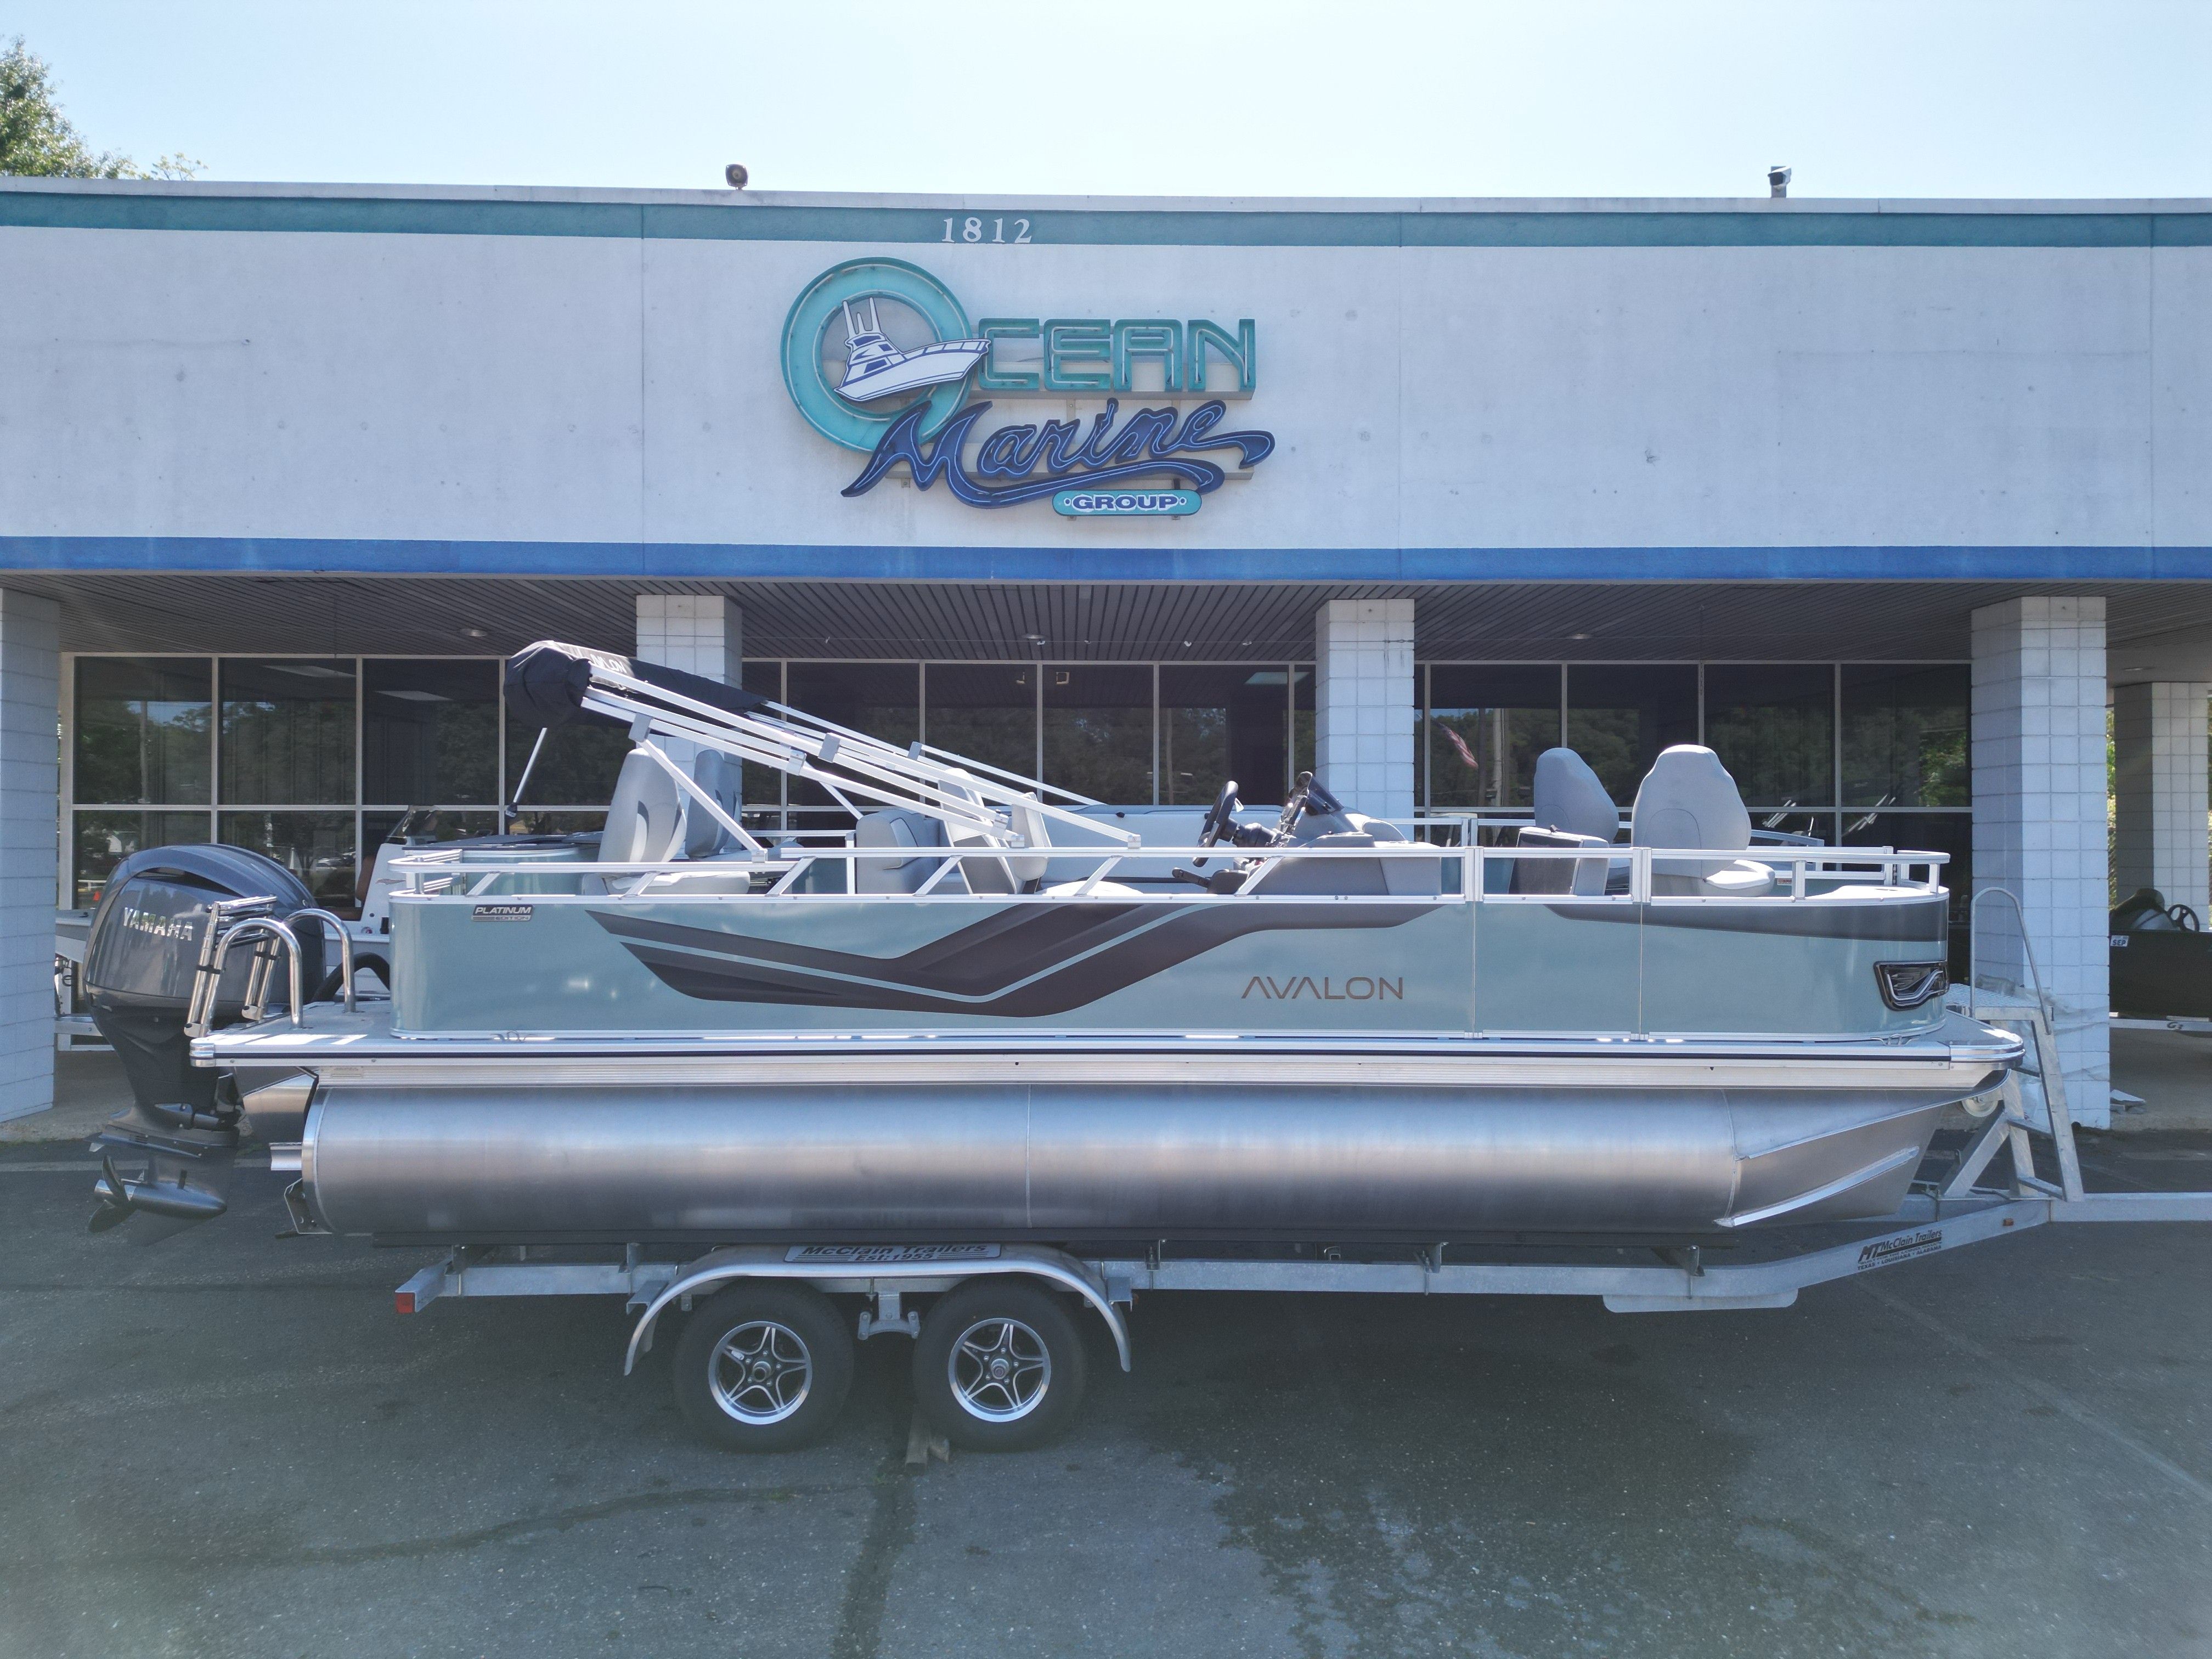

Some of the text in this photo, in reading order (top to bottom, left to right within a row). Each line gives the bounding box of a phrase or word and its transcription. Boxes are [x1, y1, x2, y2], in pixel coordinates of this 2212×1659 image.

[941, 217, 1032, 243] 1812
[781, 256, 1256, 453] OCEAN
[840, 397, 1276, 510] Marine
[1072, 495, 1179, 510] GROUP
[123, 907, 193, 941] YAMAHA
[1241, 976, 1403, 1000] AVALON
[802, 1245, 988, 1255] McClain Trailers
[1881, 1229, 1942, 1251] McClain Trailers
[1858, 1245, 1942, 1270] TEXAS LOUISIANA ALABAMA
